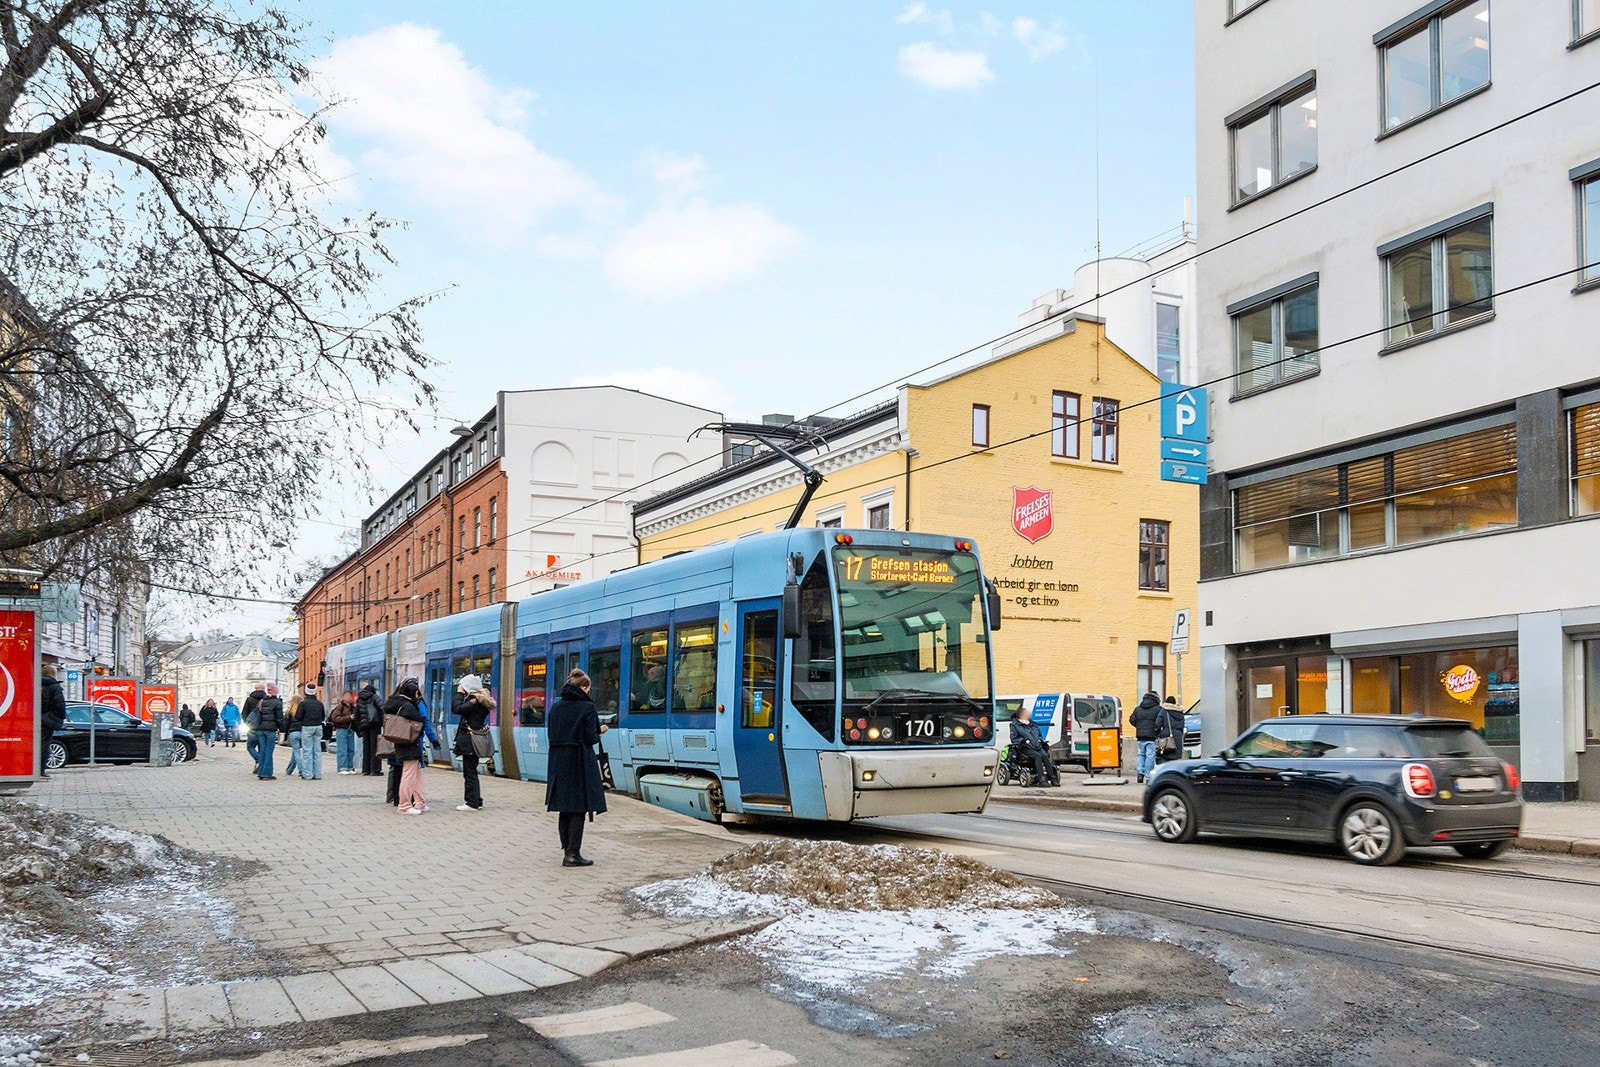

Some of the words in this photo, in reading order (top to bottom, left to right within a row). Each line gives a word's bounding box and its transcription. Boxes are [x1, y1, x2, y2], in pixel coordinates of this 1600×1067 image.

[1176, 403, 1196, 436] P
[1016, 493, 1050, 522] FRELSES
[1019, 506, 1049, 531] ARMEEN
[846, 555, 863, 581] 17
[870, 557, 910, 571] Grefsen
[913, 559, 949, 574] stasjon
[1010, 554, 1054, 570] Jobben
[991, 576, 1025, 589] Arbeid
[1028, 579, 1041, 592] gir
[1044, 581, 1056, 591] en
[1058, 579, 1079, 593] lønn
[1015, 596, 1028, 607] og
[1030, 596, 1041, 606] et
[1176, 613, 1186, 635] P
[1036, 699, 1055, 708] HYRE
[905, 719, 935, 737] 170
